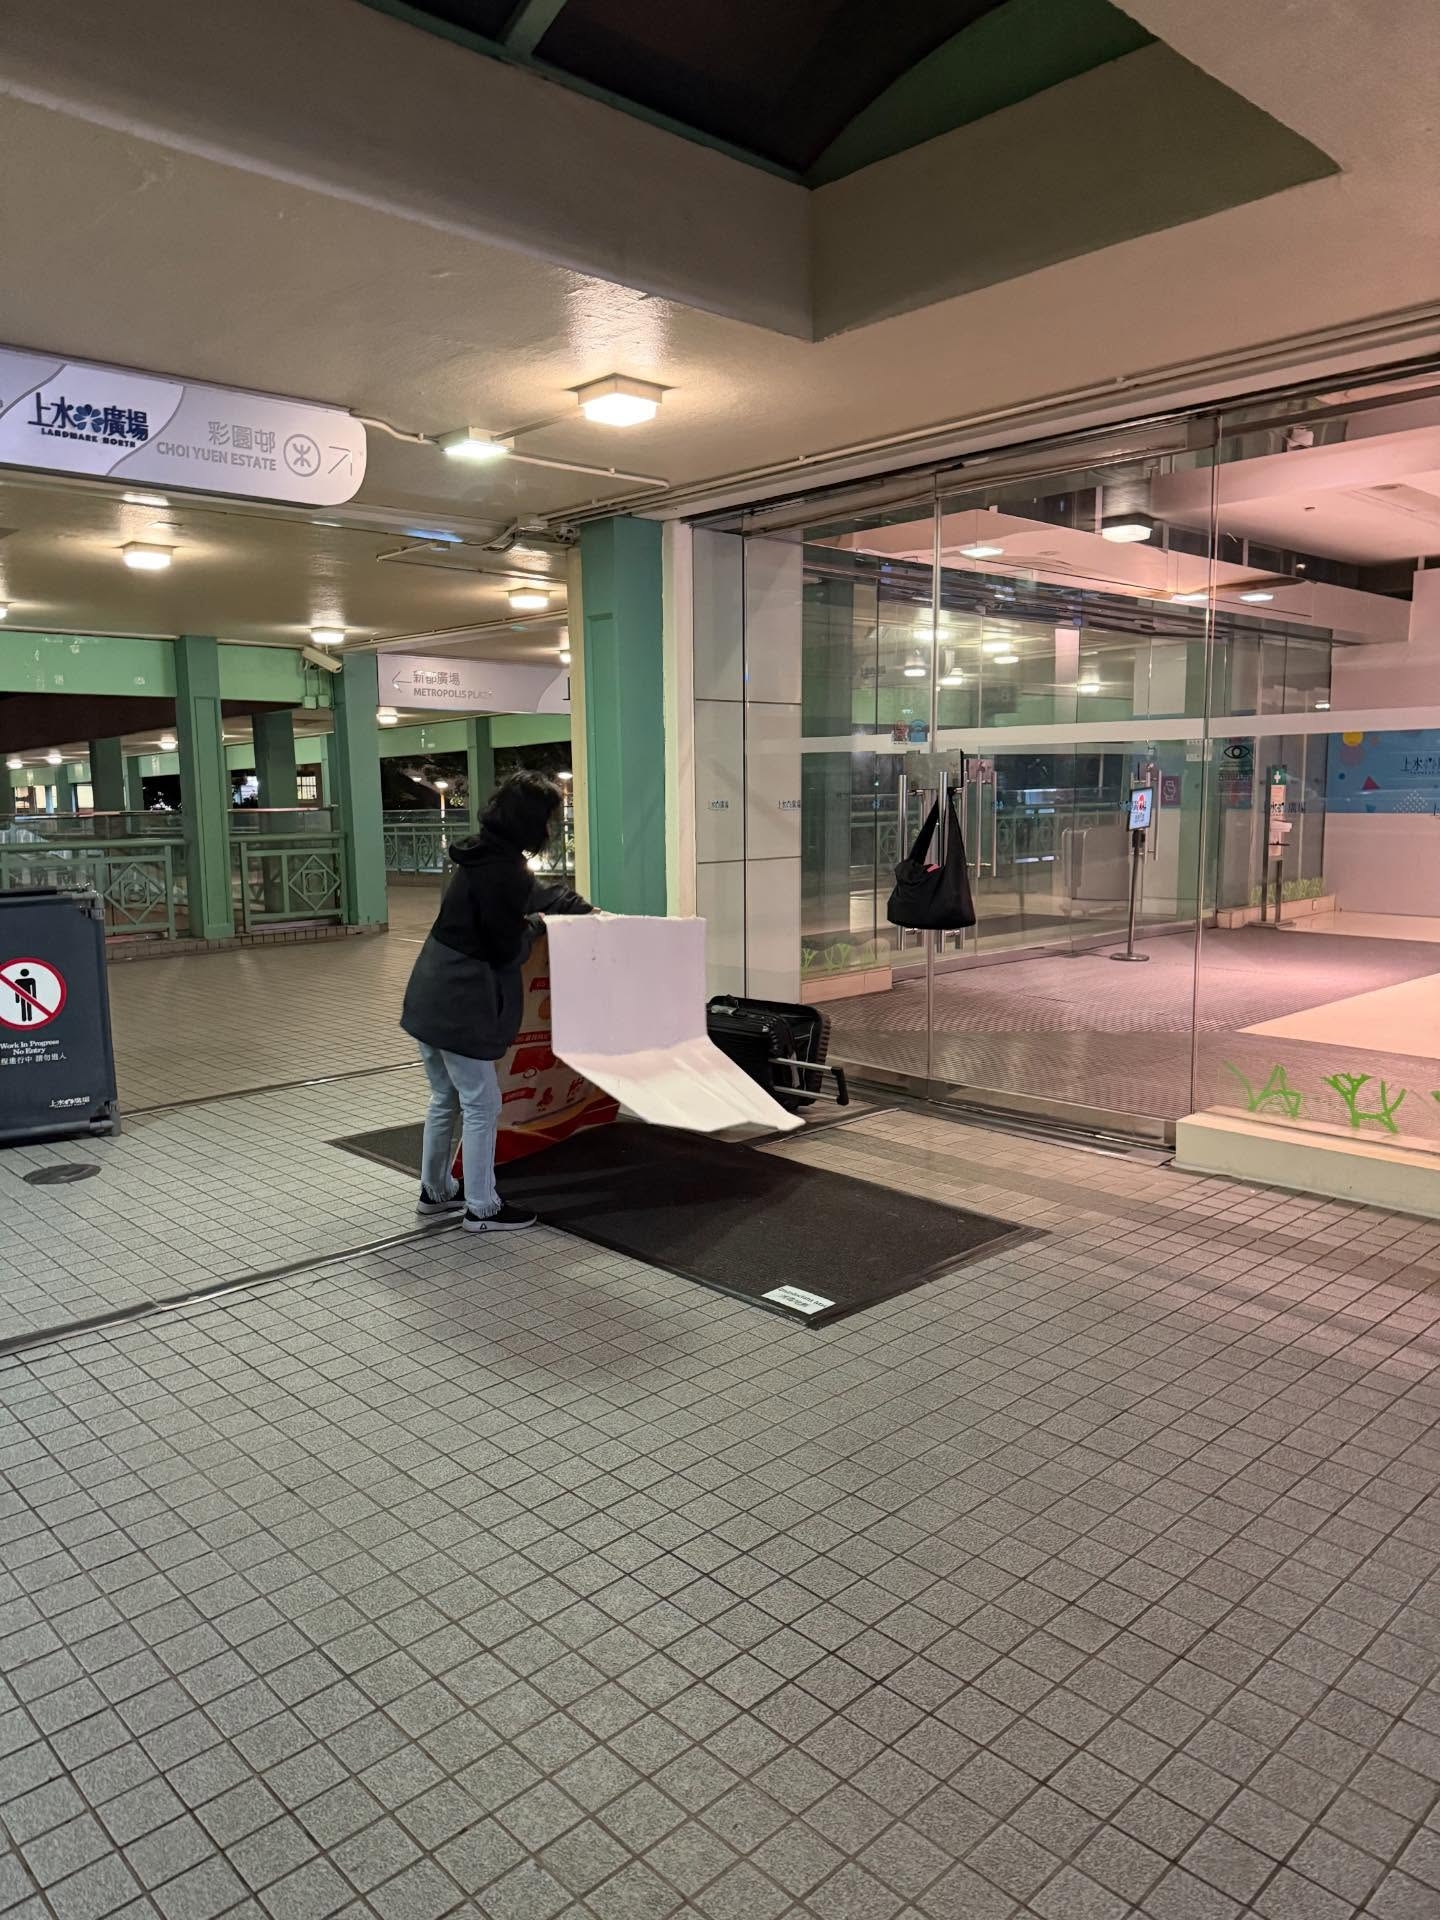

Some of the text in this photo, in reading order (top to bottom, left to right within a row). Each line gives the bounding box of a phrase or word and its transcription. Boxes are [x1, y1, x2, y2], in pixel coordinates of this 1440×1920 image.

[27, 392, 149, 441] 上水廣場
[41, 427, 136, 448] LANDMARK NORTH
[207, 421, 276, 454] 彩園邨
[156, 441, 278, 471] CHOI YUEN ESTATE
[412, 670, 461, 686] 新都廣場
[413, 688, 466, 698] METROPOLIS
